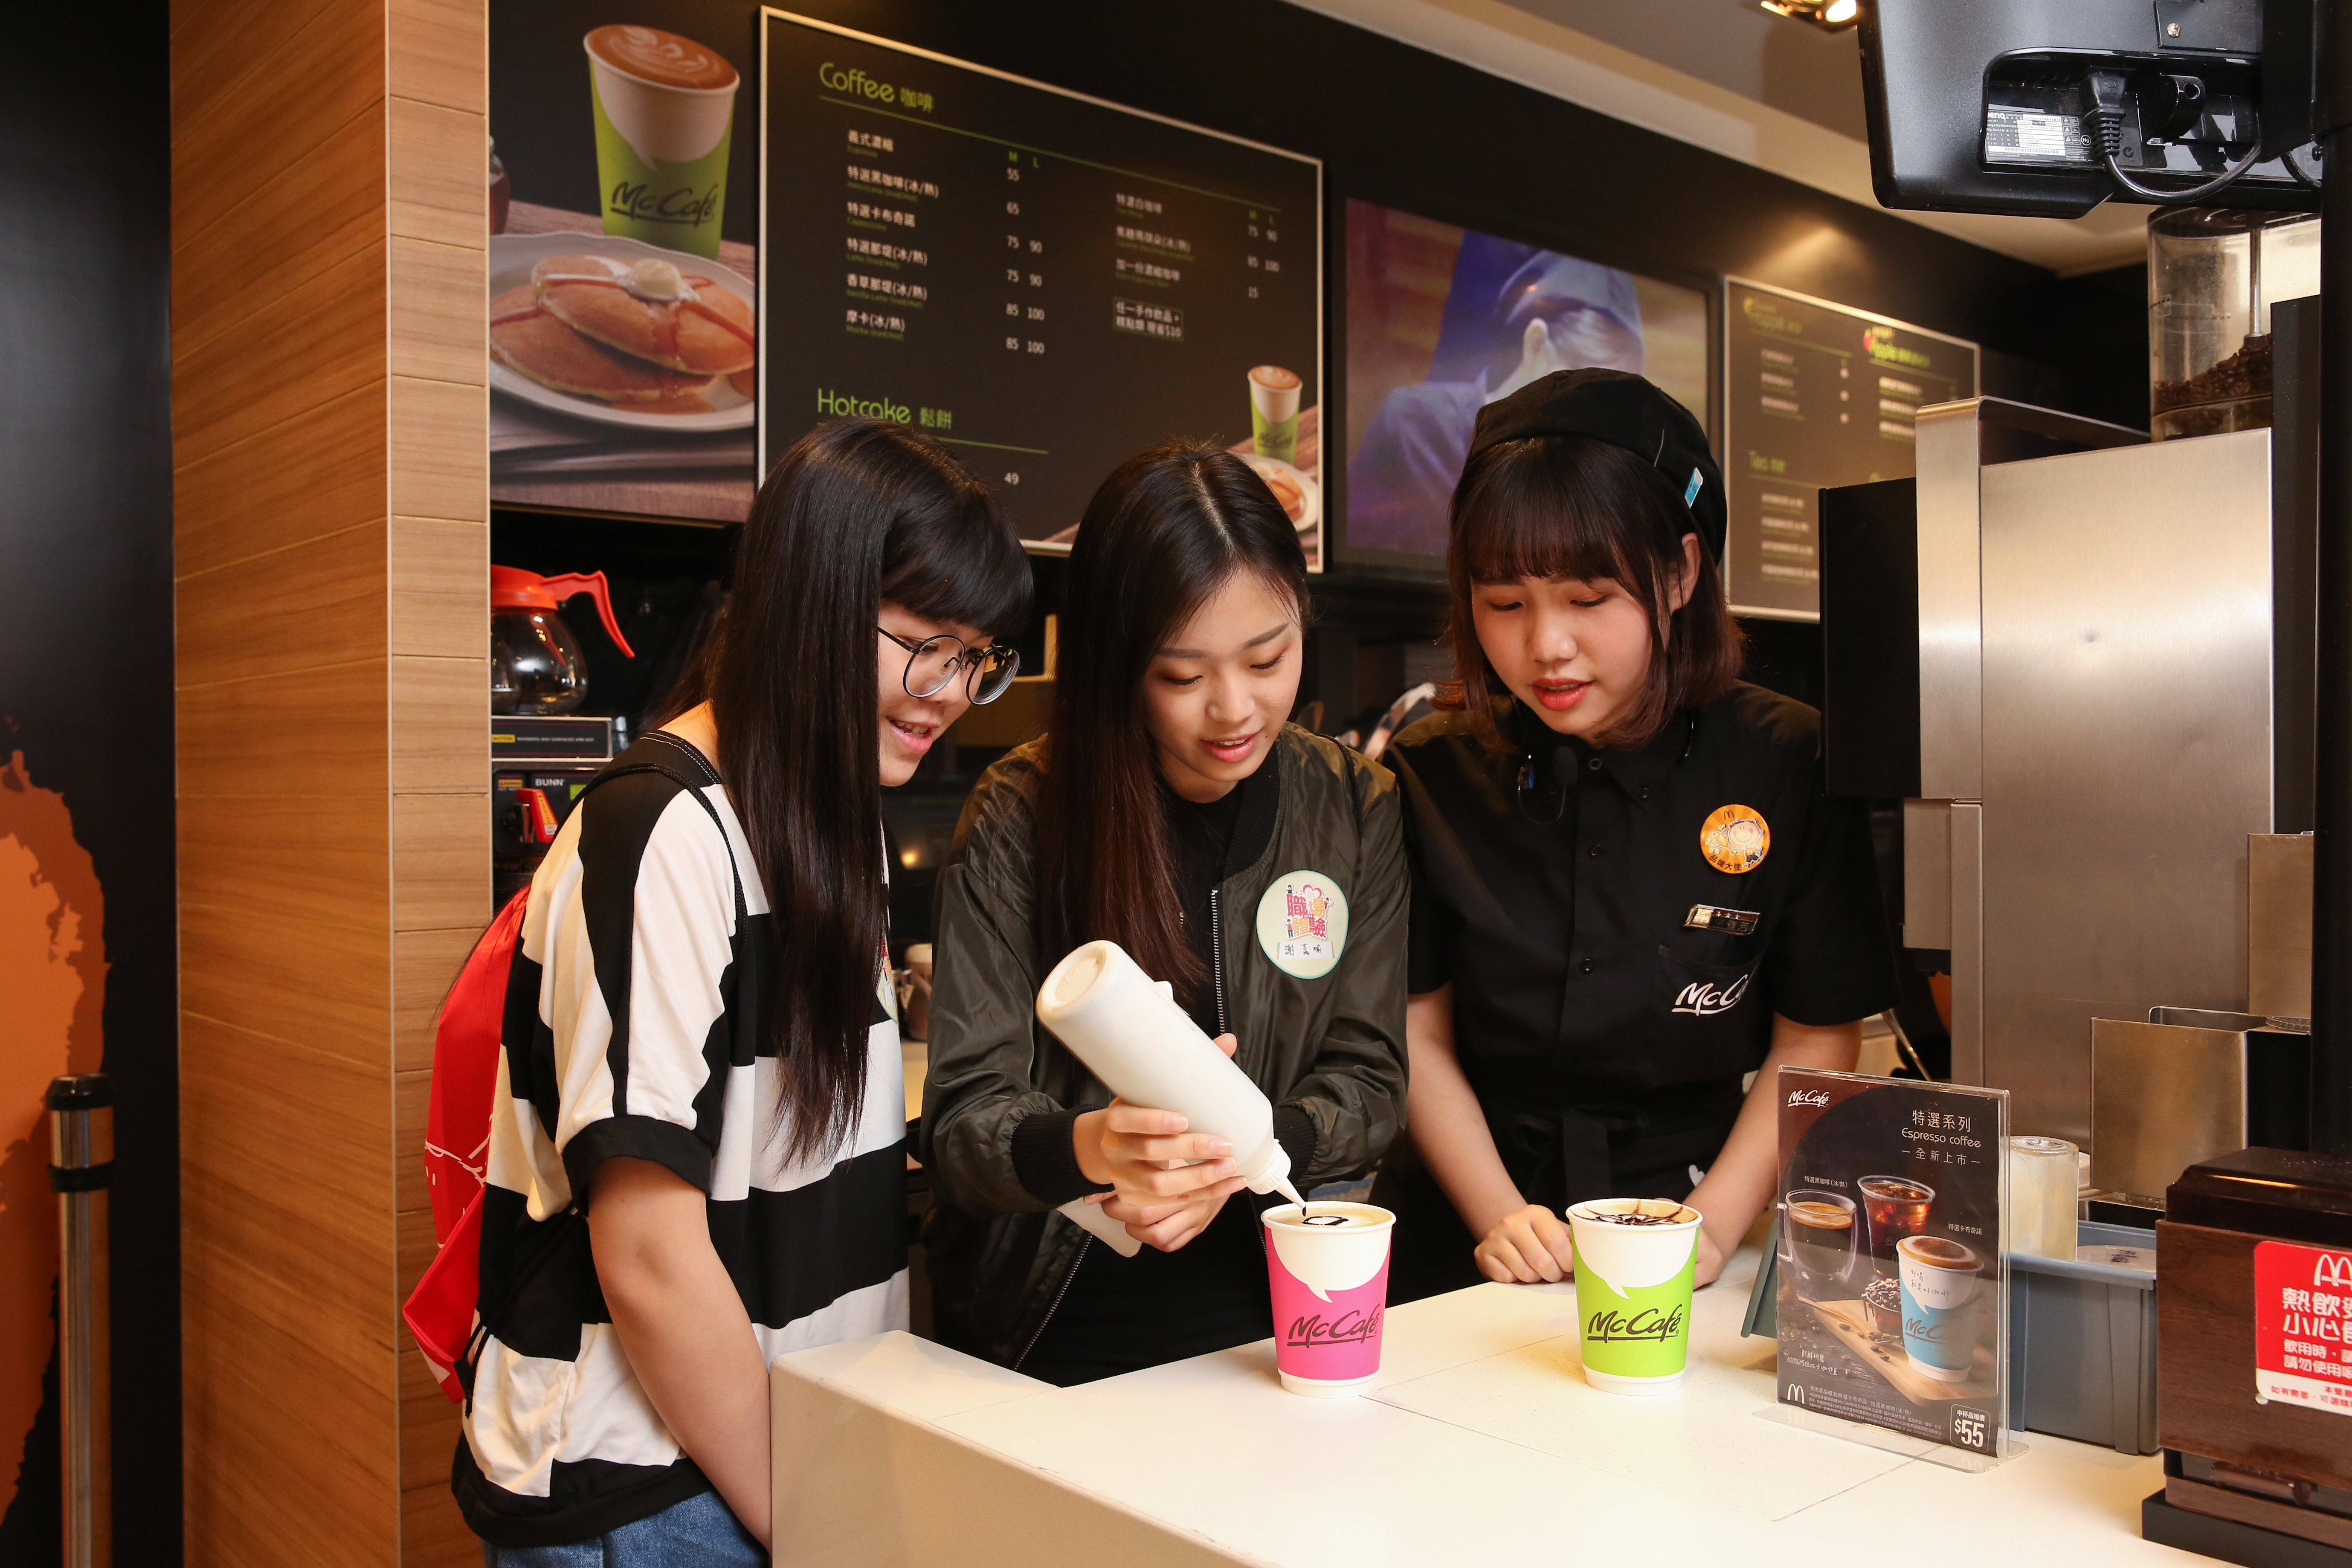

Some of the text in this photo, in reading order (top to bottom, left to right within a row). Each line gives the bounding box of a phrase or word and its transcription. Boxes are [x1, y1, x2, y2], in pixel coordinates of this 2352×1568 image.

[819, 62, 895, 103] Coffee
[1009, 151, 1039, 168] M L
[610, 181, 719, 228] McCafé
[1007, 235, 1042, 253] 75 90
[1007, 269, 1042, 287] 75 90
[1006, 302, 1045, 321] 85 100
[1006, 337, 1045, 354] 85 100
[817, 387, 911, 424] Hotcake
[535, 778, 563, 786] BUNN
[1708, 853, 1742, 871] 品牌大使
[1286, 893, 1326, 918] 職場
[1292, 917, 1326, 938] 體驗
[1787, 1090, 1830, 1107] McCafé
[1912, 1110, 1971, 1132] 特選系列
[1902, 1127, 1981, 1148] Espresso coffee
[1948, 1223, 1982, 1235] 特選卡布奇諾
[1287, 1303, 1380, 1348] McCafé
[1587, 1304, 1682, 1343] McCafé
[1954, 1418, 1985, 1448] $55
